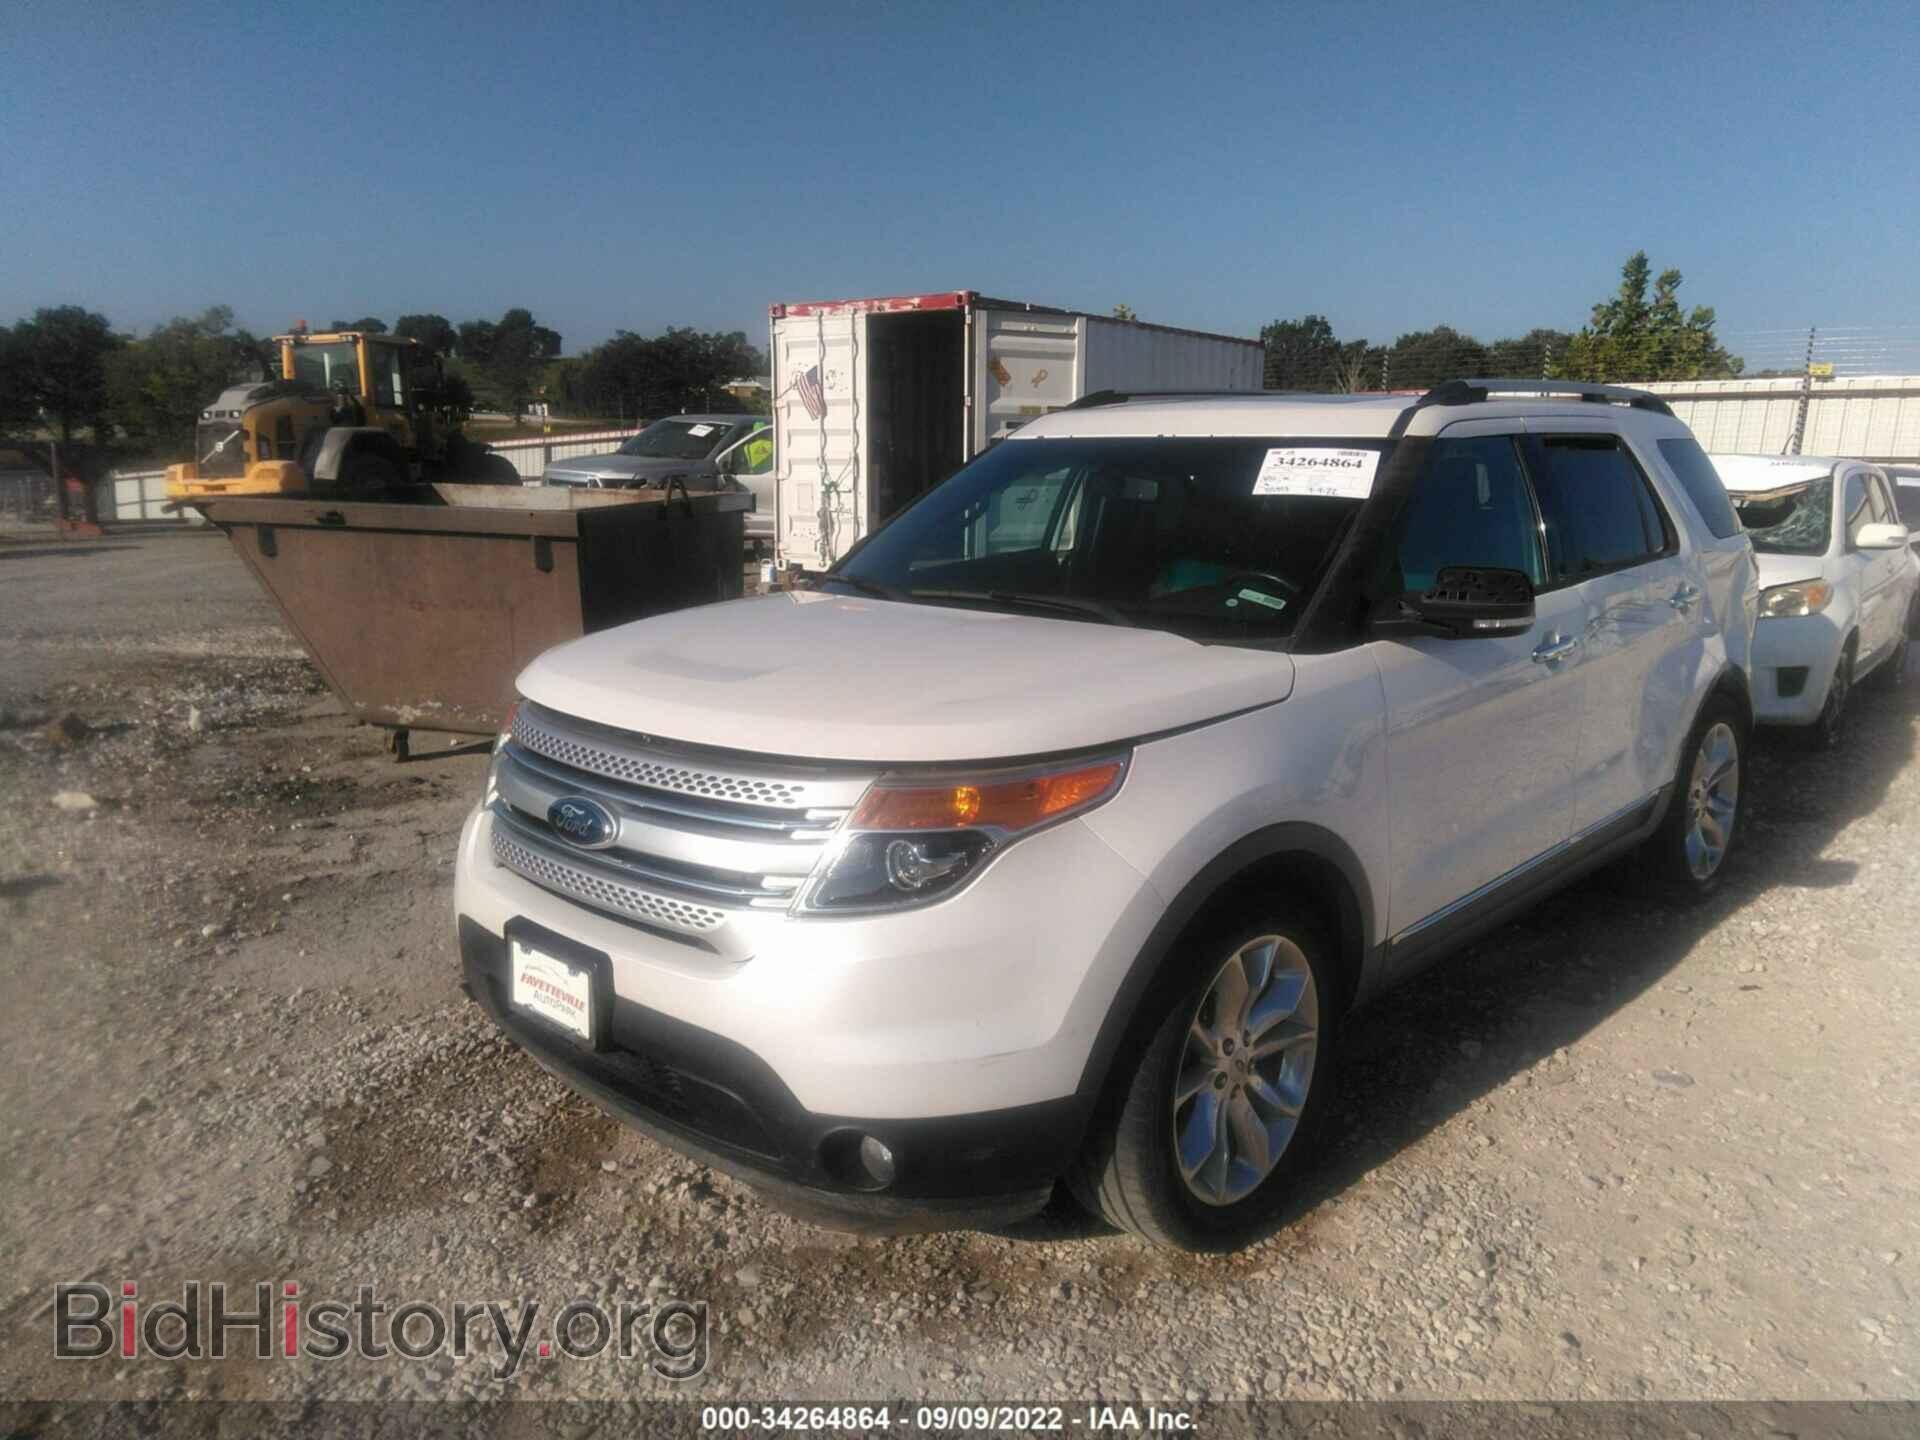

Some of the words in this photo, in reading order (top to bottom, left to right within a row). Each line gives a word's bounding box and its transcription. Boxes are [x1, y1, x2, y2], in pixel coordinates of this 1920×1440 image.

[1273, 456, 1363, 469] 34264864
[555, 803, 594, 836] Ford
[520, 972, 585, 1012] FAYETTEVILLE
